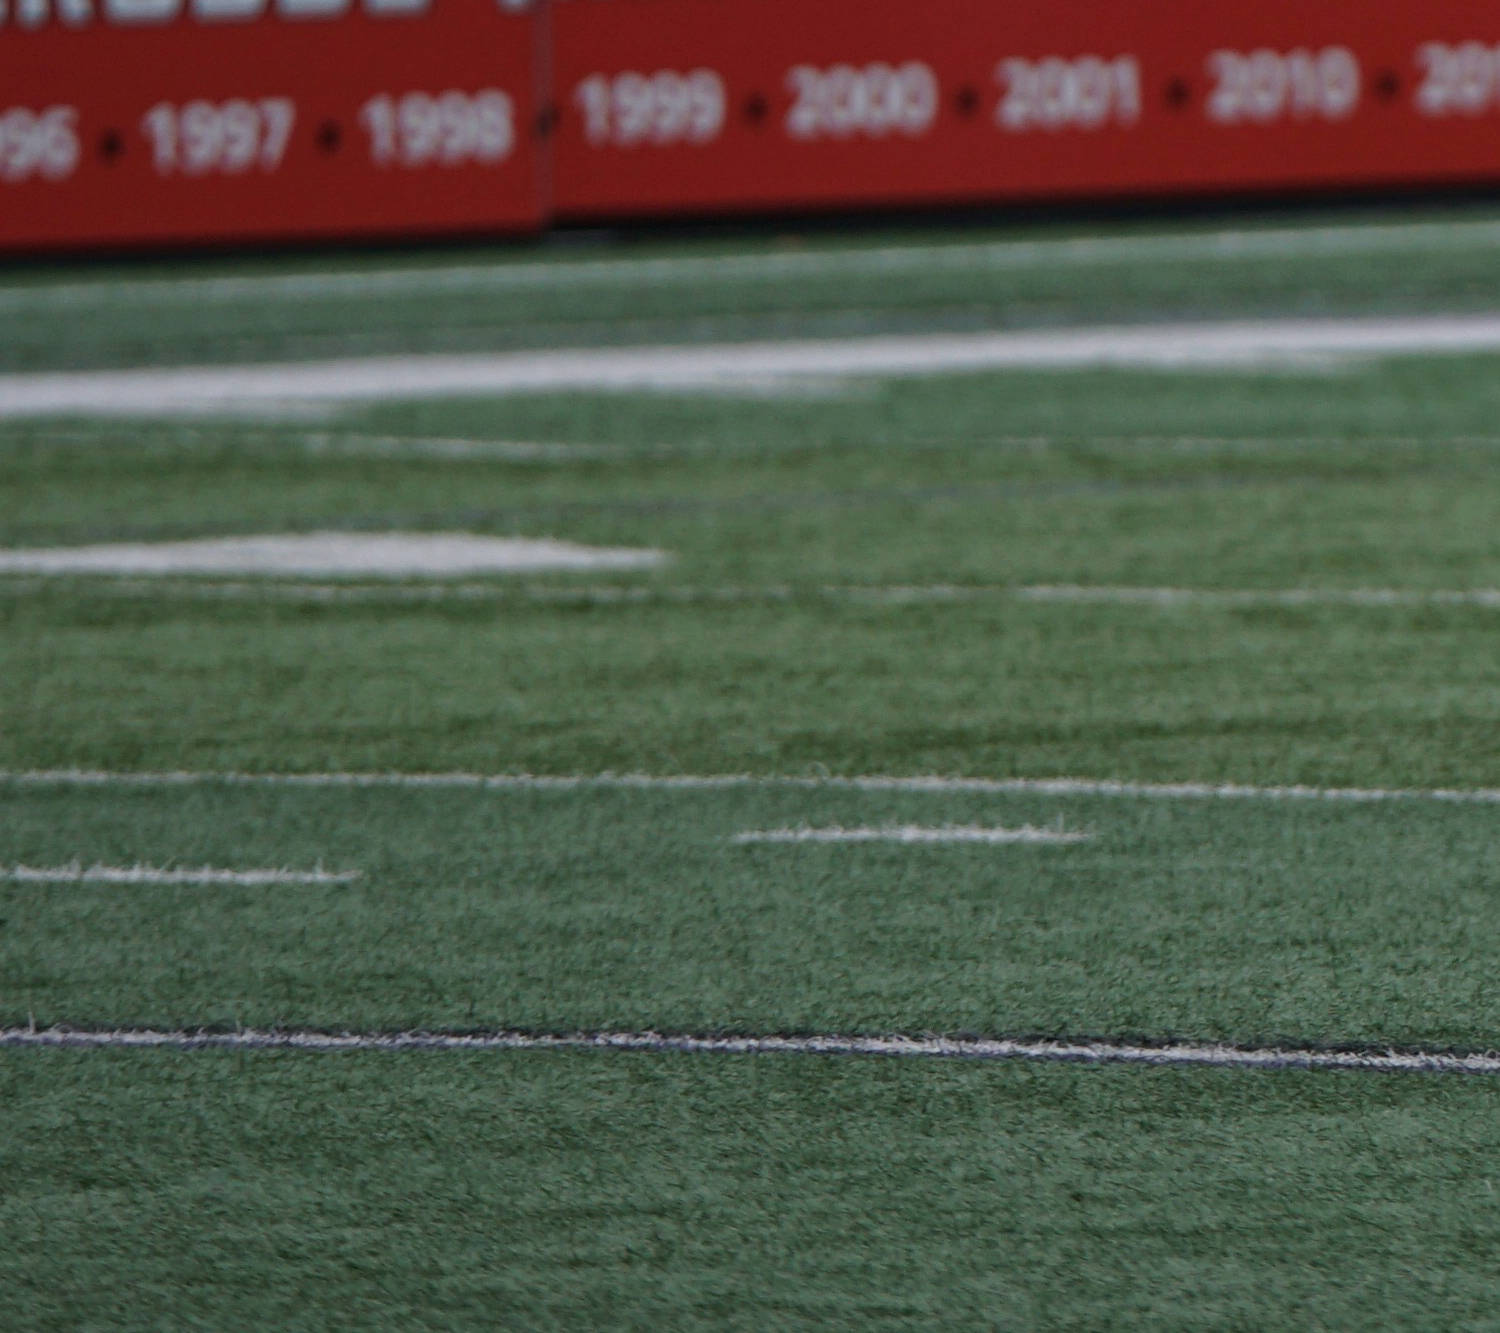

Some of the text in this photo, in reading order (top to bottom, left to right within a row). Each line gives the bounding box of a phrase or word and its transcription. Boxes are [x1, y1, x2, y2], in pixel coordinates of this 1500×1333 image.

[142, 97, 296, 177] 1997
[358, 87, 516, 167] 1998
[572, 67, 726, 147] 1999
[784, 59, 938, 139] 2000
[994, 53, 1143, 131] 2001
[1206, 45, 1360, 124] 2010
